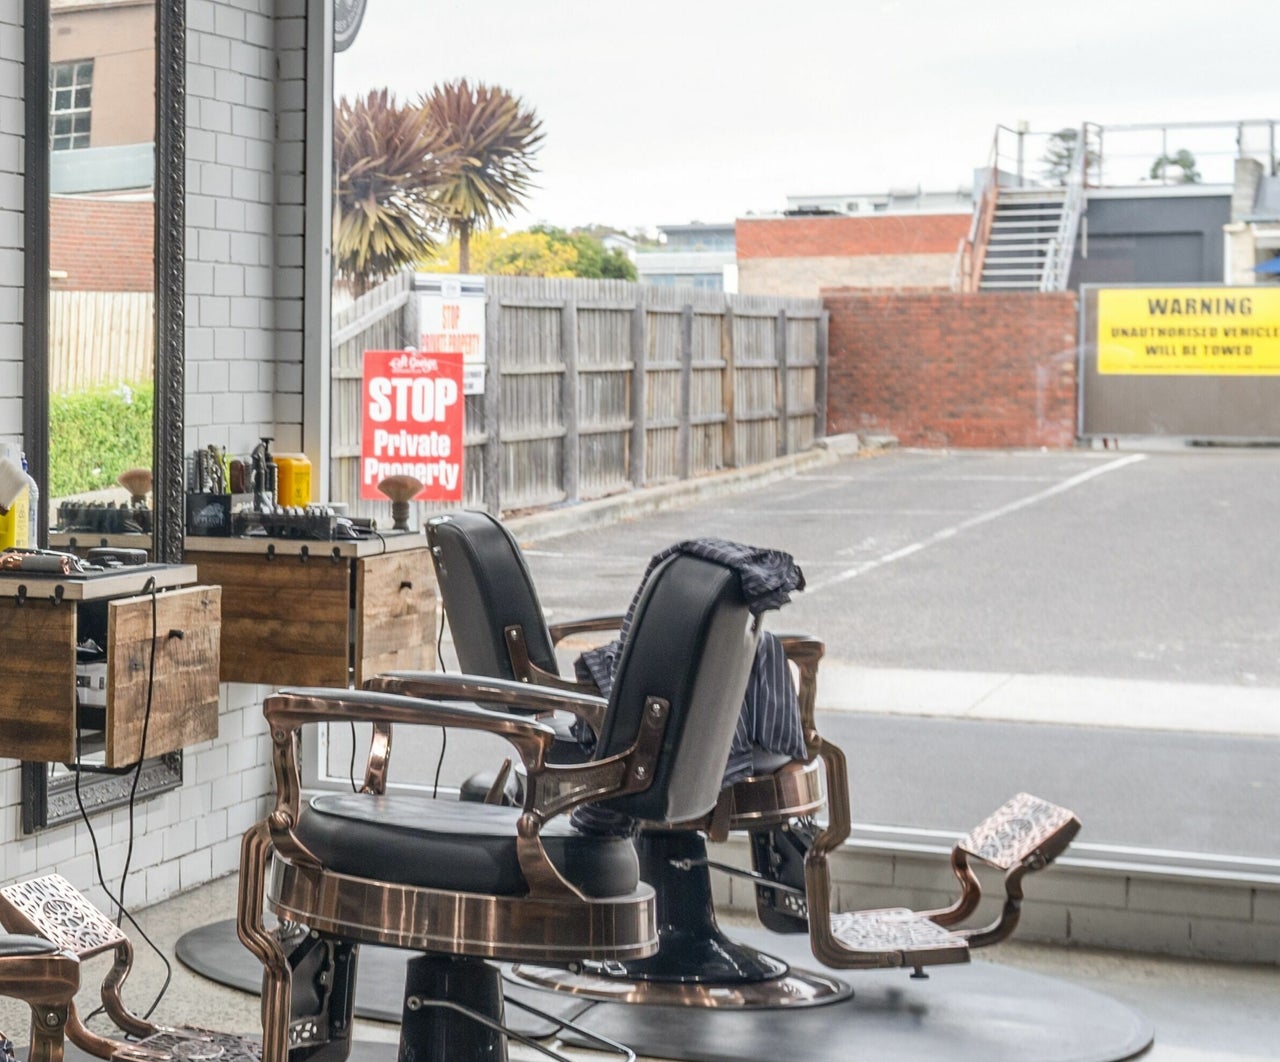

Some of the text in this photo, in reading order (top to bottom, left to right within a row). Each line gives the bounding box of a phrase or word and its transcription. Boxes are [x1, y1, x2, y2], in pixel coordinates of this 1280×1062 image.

[1147, 298, 1253, 316] WARNING
[1145, 345, 1253, 356] WILL BE TOWED
[369, 376, 458, 422] STOP
[374, 429, 451, 457] Private
